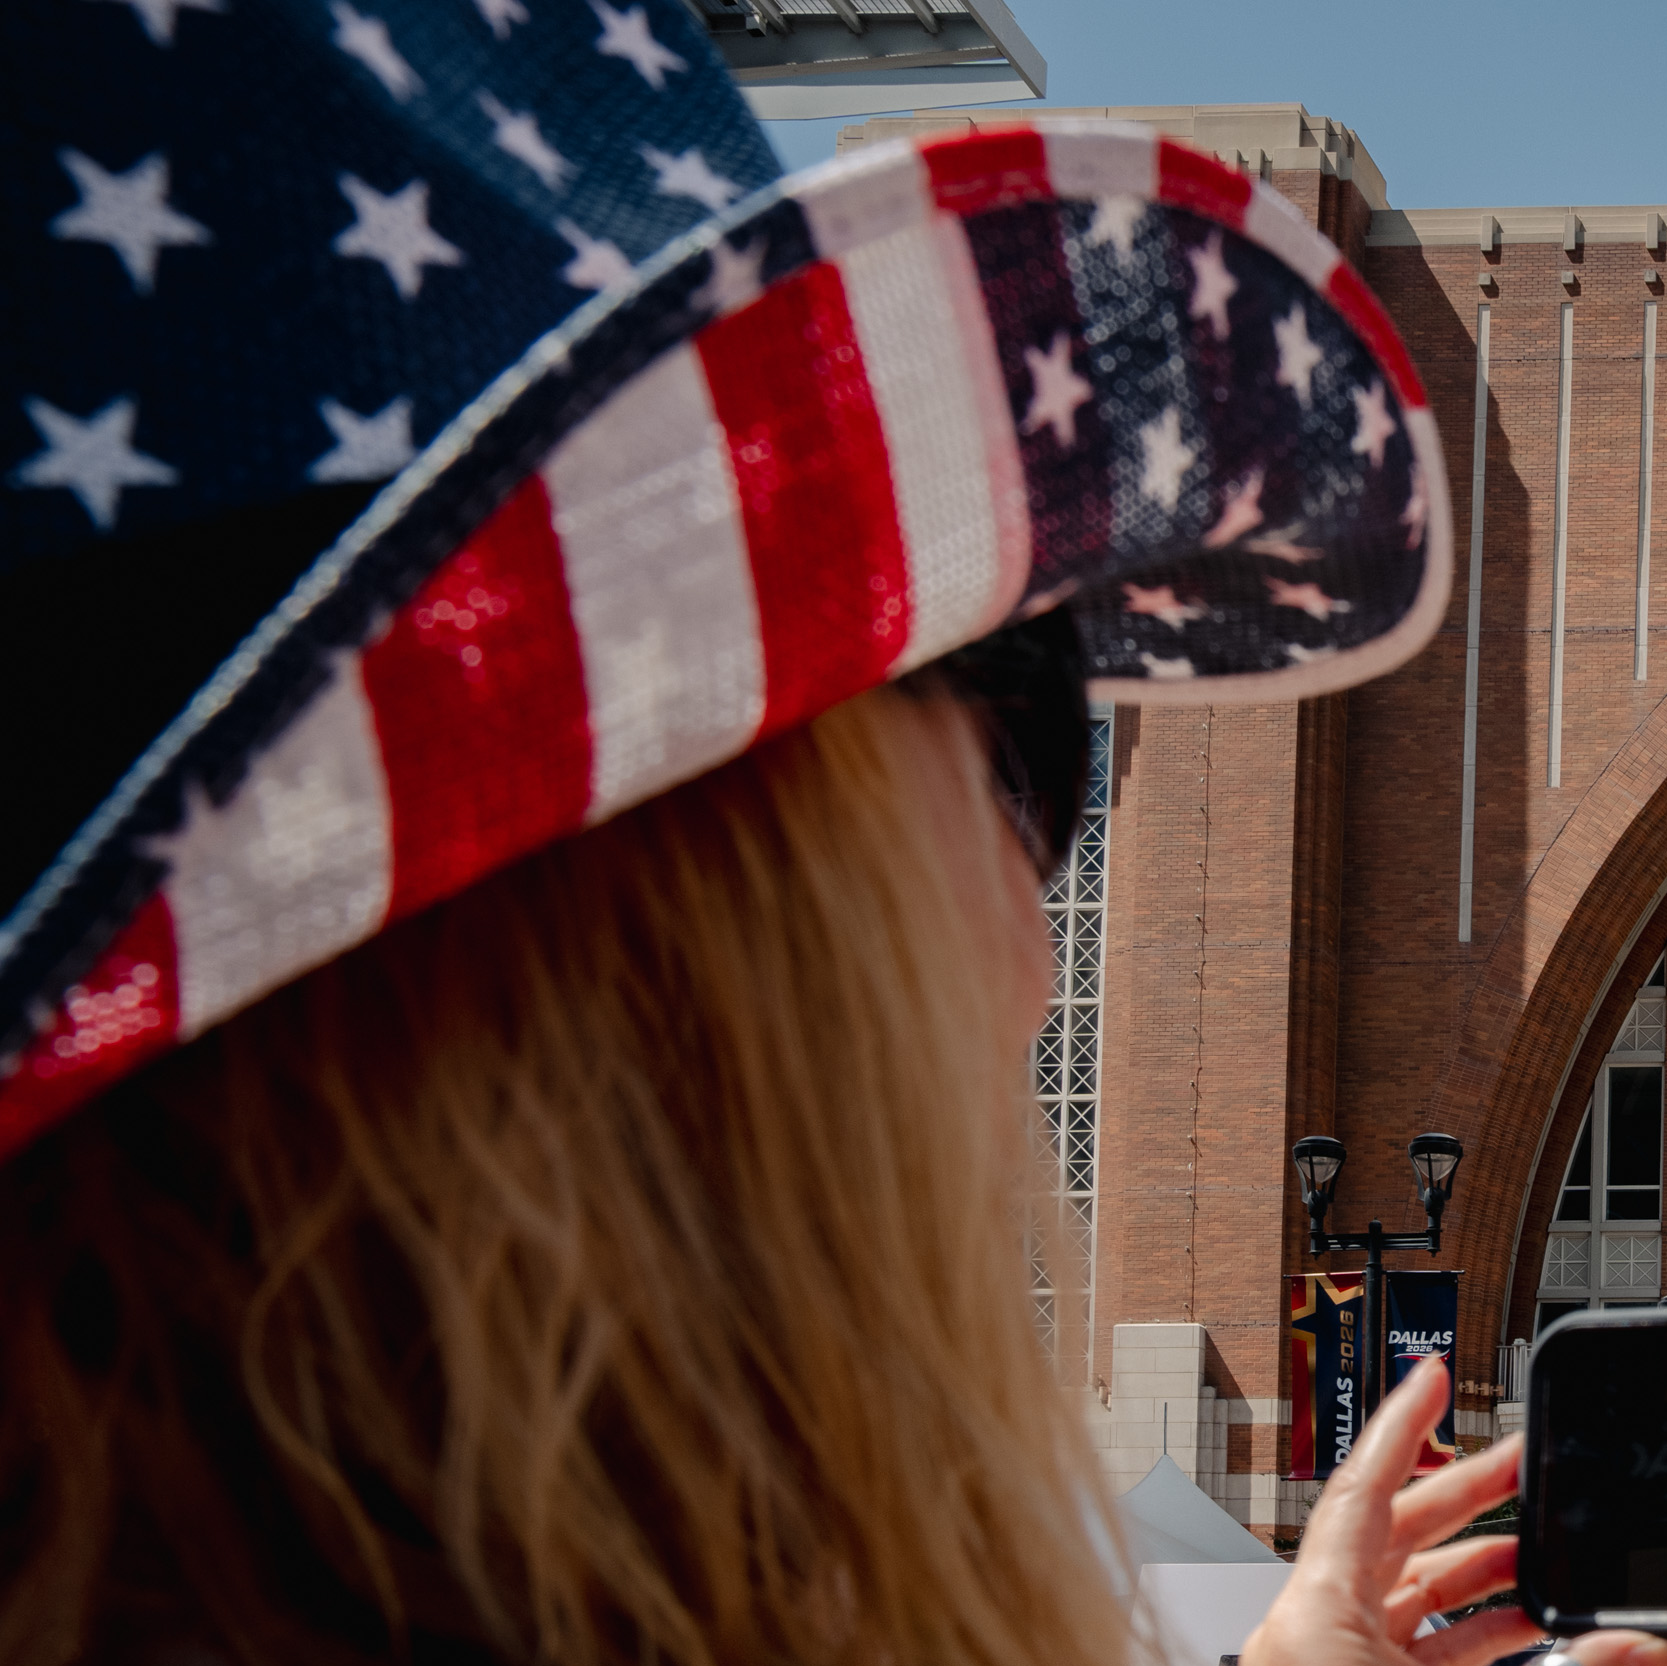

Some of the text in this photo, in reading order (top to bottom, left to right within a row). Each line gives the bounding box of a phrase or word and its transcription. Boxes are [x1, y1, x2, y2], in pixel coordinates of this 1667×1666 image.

[1388, 1331, 1453, 1345] DALLAS
[1335, 1310, 1354, 1464] DALLAS 2026
